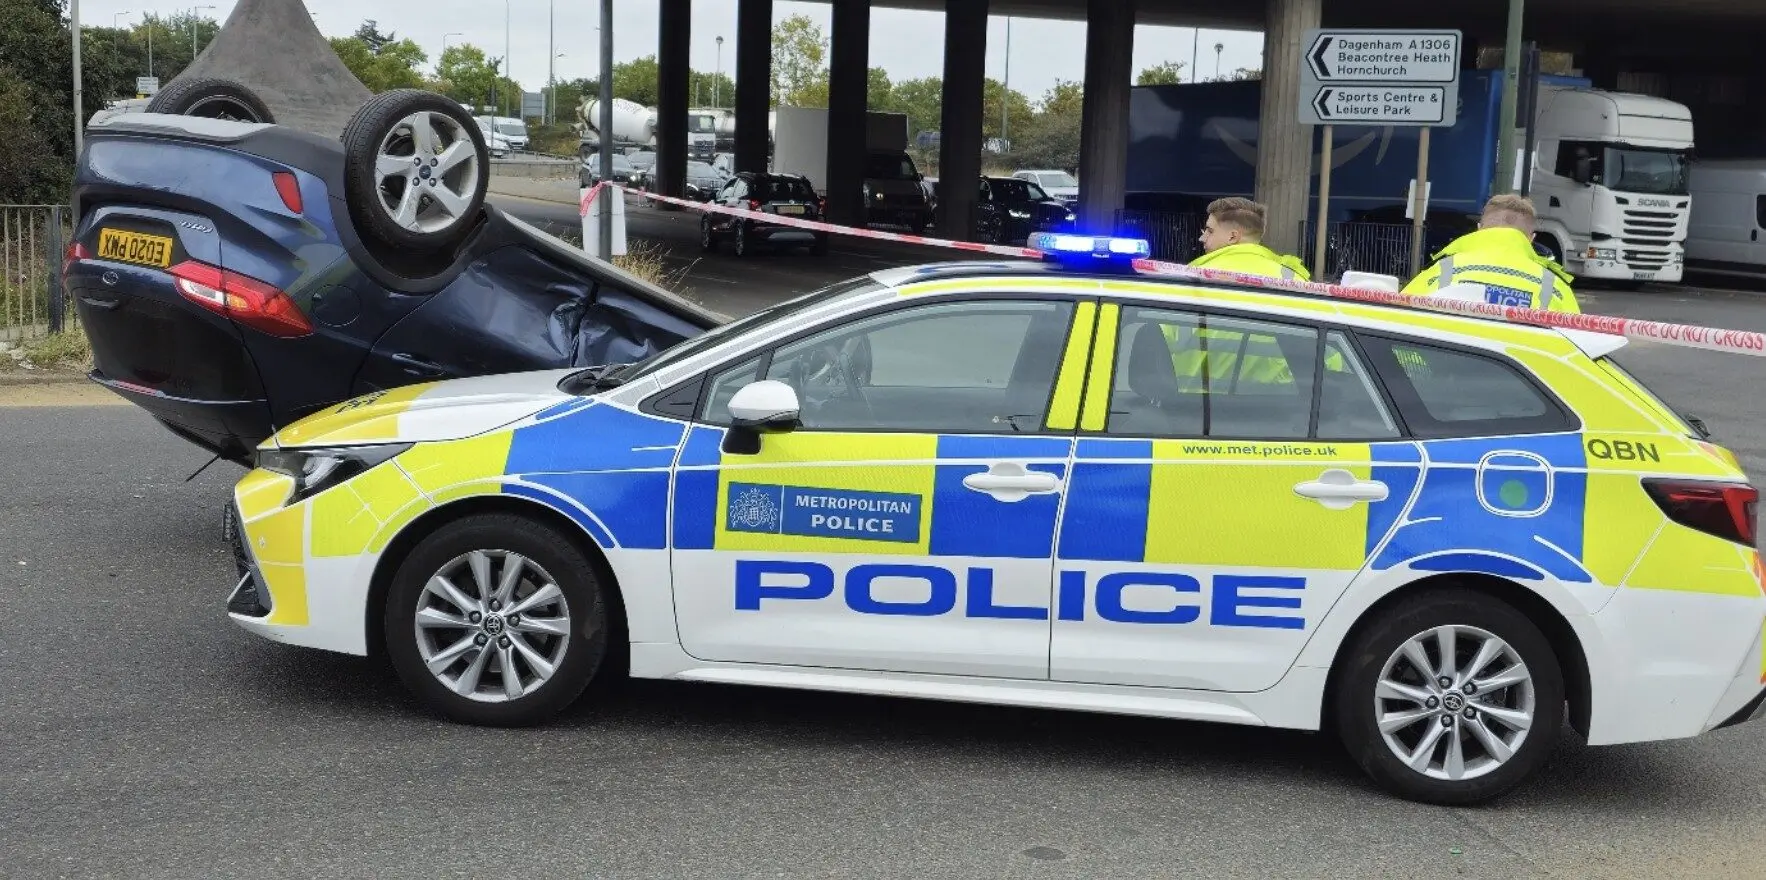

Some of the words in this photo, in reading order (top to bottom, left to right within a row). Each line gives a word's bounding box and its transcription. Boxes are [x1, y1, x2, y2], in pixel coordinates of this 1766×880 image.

[1338, 39, 1403, 52] Dagenham
[1338, 52, 1409, 63] Beacontree
[1413, 53, 1451, 63] Heath
[1337, 65, 1407, 75] Hornchurch
[1338, 92, 1379, 104] Sports
[1383, 92, 1425, 102] Centre
[1429, 93, 1438, 102] &
[1336, 105, 1379, 115] Leisure
[1383, 105, 1411, 115] Park
[1637, 198, 1670, 208] SCANIA
[1486, 286, 1531, 300] OPOLITAN
[1486, 294, 1531, 308] LICE
[1630, 321, 1658, 338] FIRE
[1714, 329, 1763, 351] CROSS
[1183, 444, 1337, 457] www.met.police.uk
[1587, 438, 1660, 462] QBN
[795, 494, 912, 514] METROPOLITAN
[811, 514, 893, 533] POLICE
[735, 559, 1307, 630] POLICE
